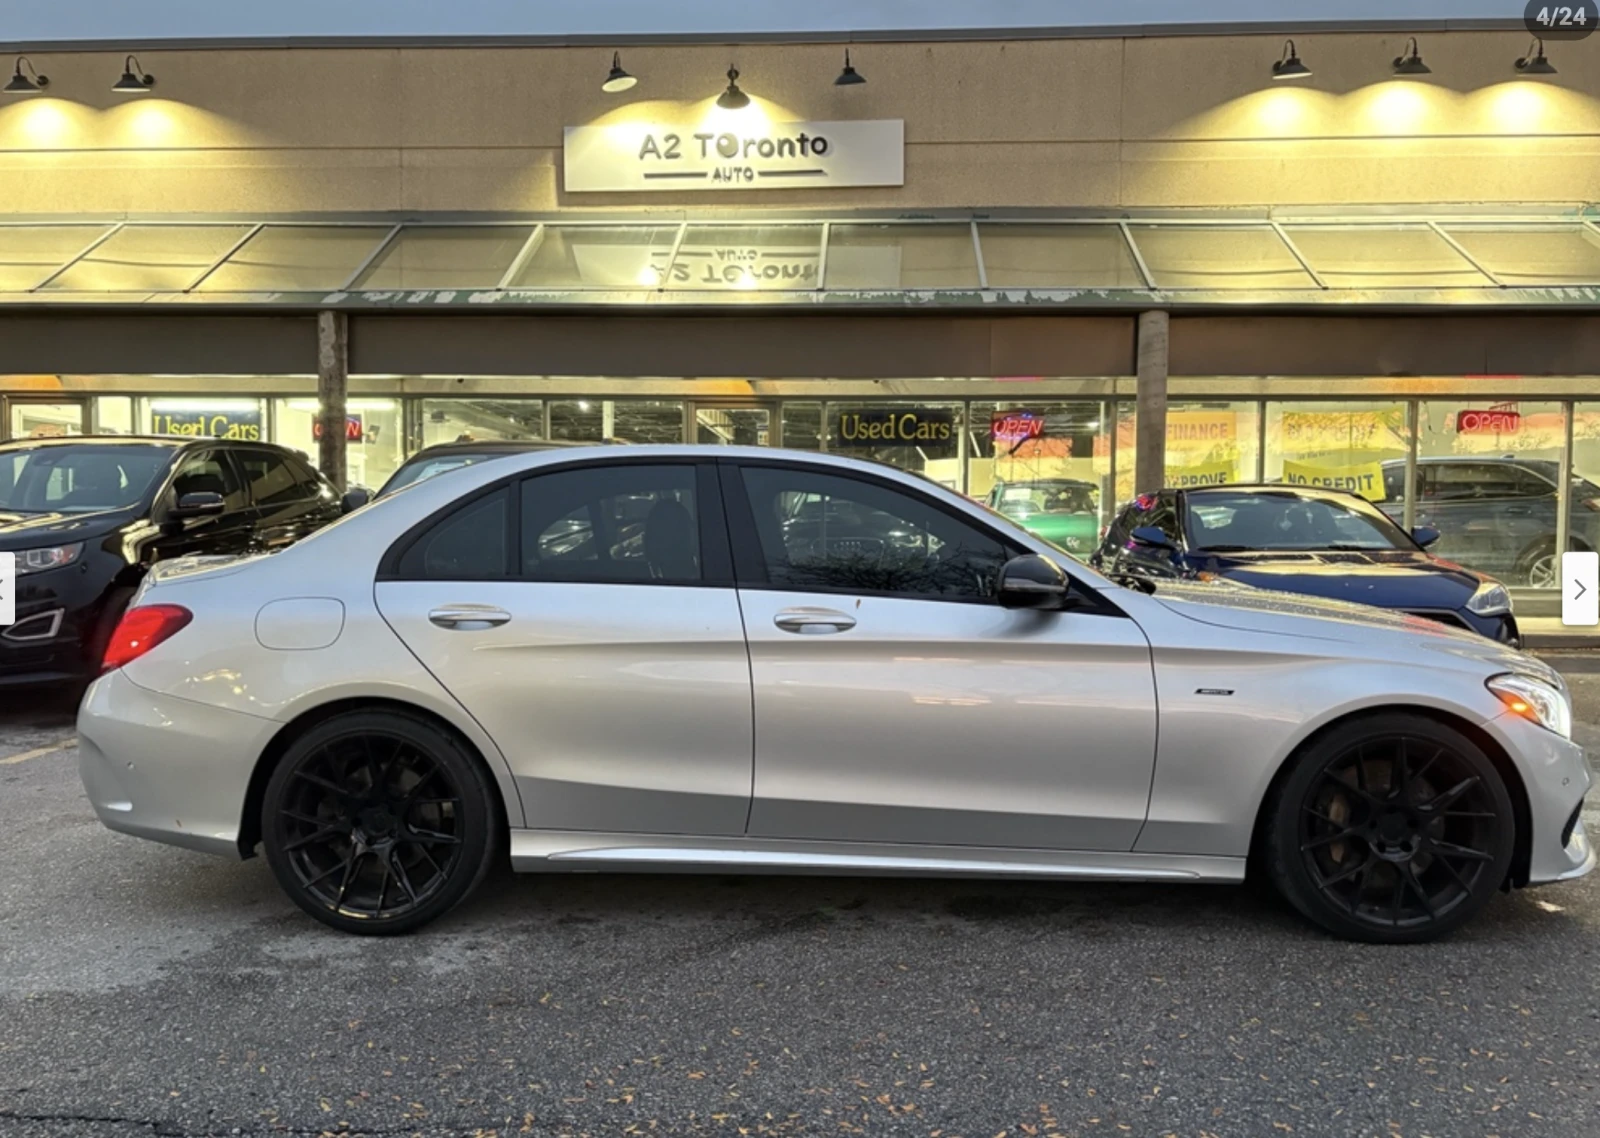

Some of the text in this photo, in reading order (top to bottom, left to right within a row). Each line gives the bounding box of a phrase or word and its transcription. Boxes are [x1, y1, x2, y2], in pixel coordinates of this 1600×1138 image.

[639, 133, 681, 160] A2
[713, 167, 754, 182] AUTO
[154, 415, 259, 440] Used Cars
[841, 413, 950, 439] Used Cars
[993, 419, 1043, 435] OPEN
[1462, 413, 1518, 432] OPEN
